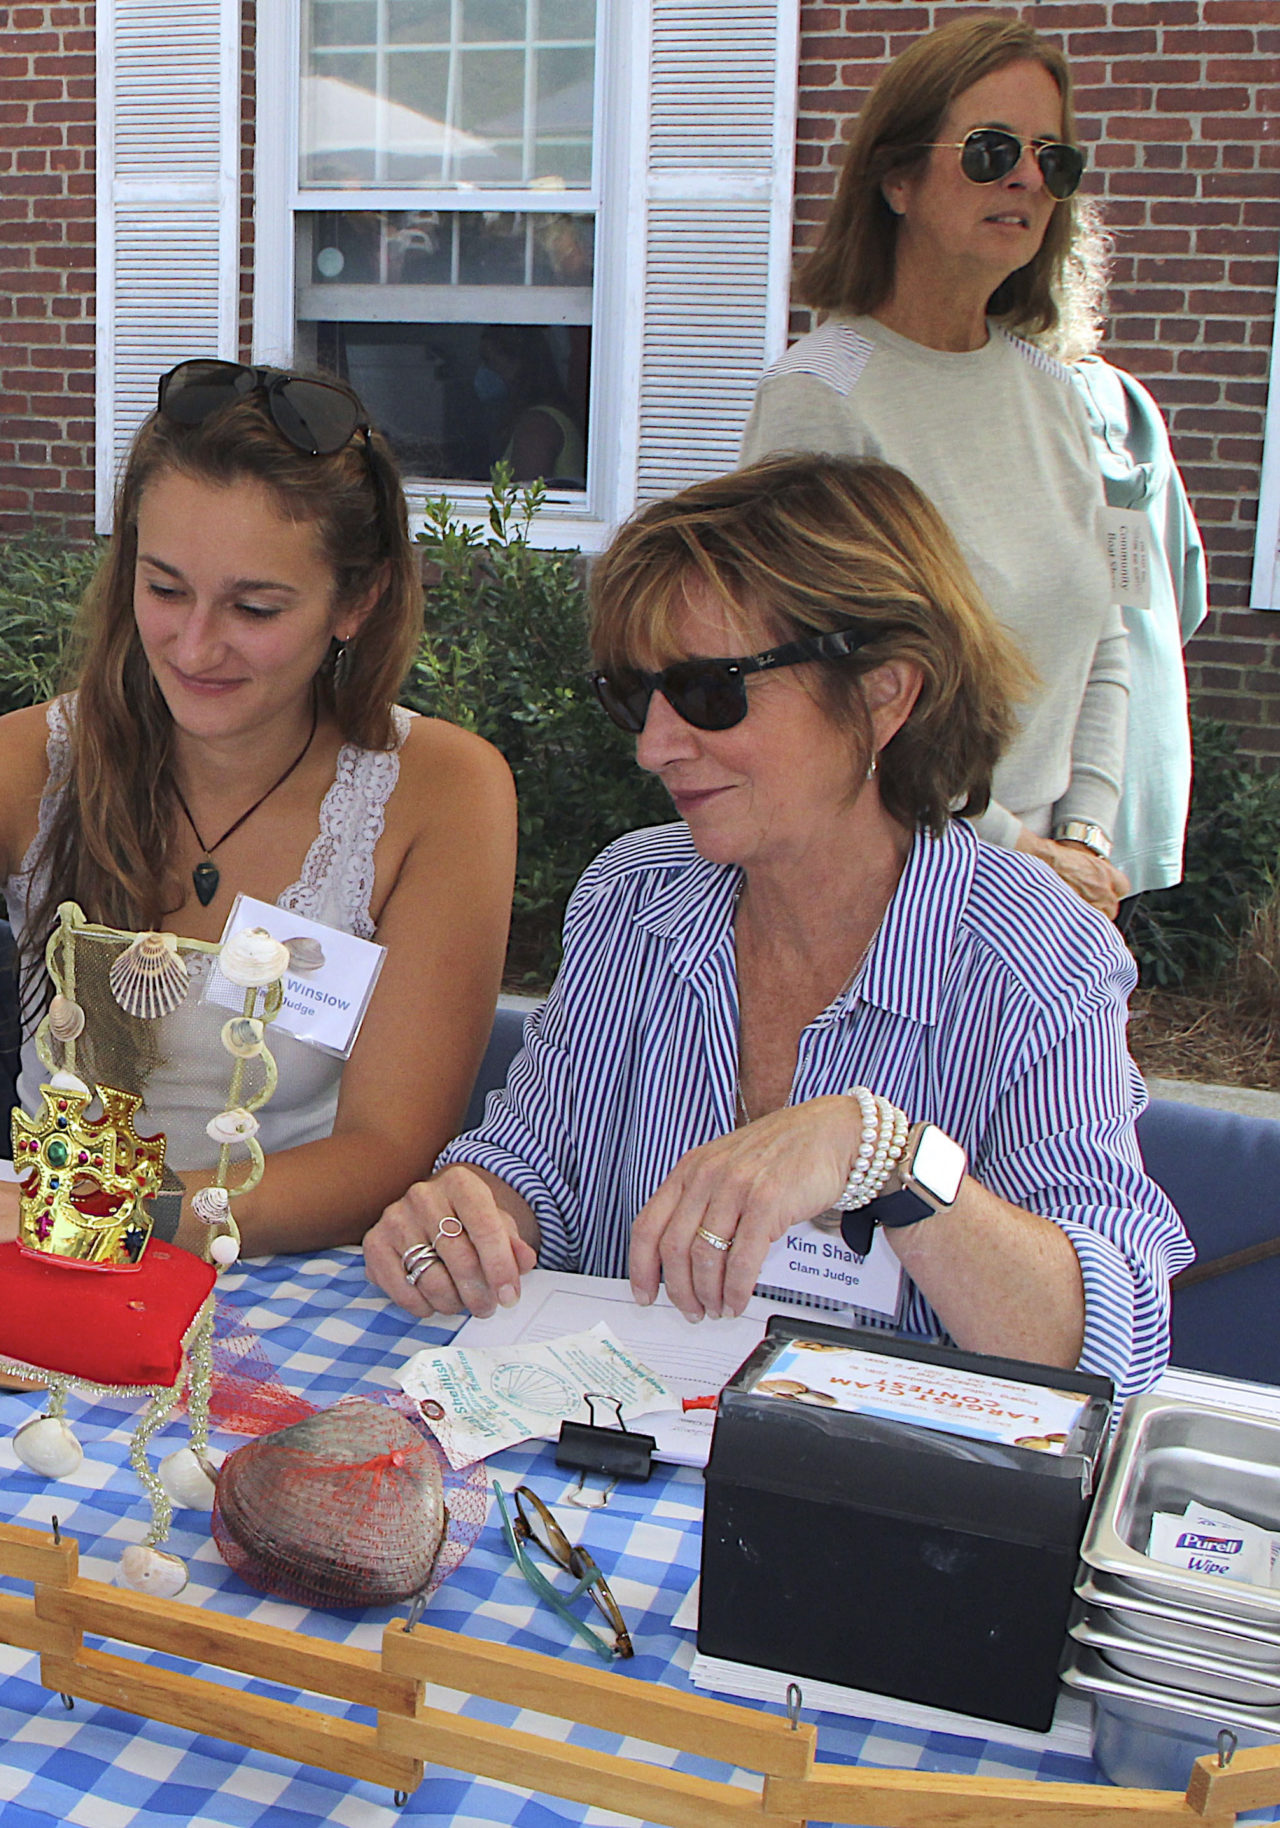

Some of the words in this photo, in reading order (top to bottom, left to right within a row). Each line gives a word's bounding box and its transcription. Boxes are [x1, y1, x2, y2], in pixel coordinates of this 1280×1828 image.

[282, 997, 315, 1016] Judge
[287, 979, 351, 1011] Winslow
[786, 1235, 817, 1255] Kim
[822, 1243, 865, 1265] Shaw
[789, 1261, 819, 1275] Clam
[823, 1269, 860, 1285] Judge
[431, 1359, 467, 1414] Shellfish
[830, 1377, 905, 1396] CLAM
[874, 1379, 1000, 1407] CONTEST
[914, 1394, 1040, 1423] LARGEST
[463, 1416, 496, 1437] Local
[1184, 1534, 1237, 1553] Purell
[1188, 1557, 1230, 1574] Wipe
